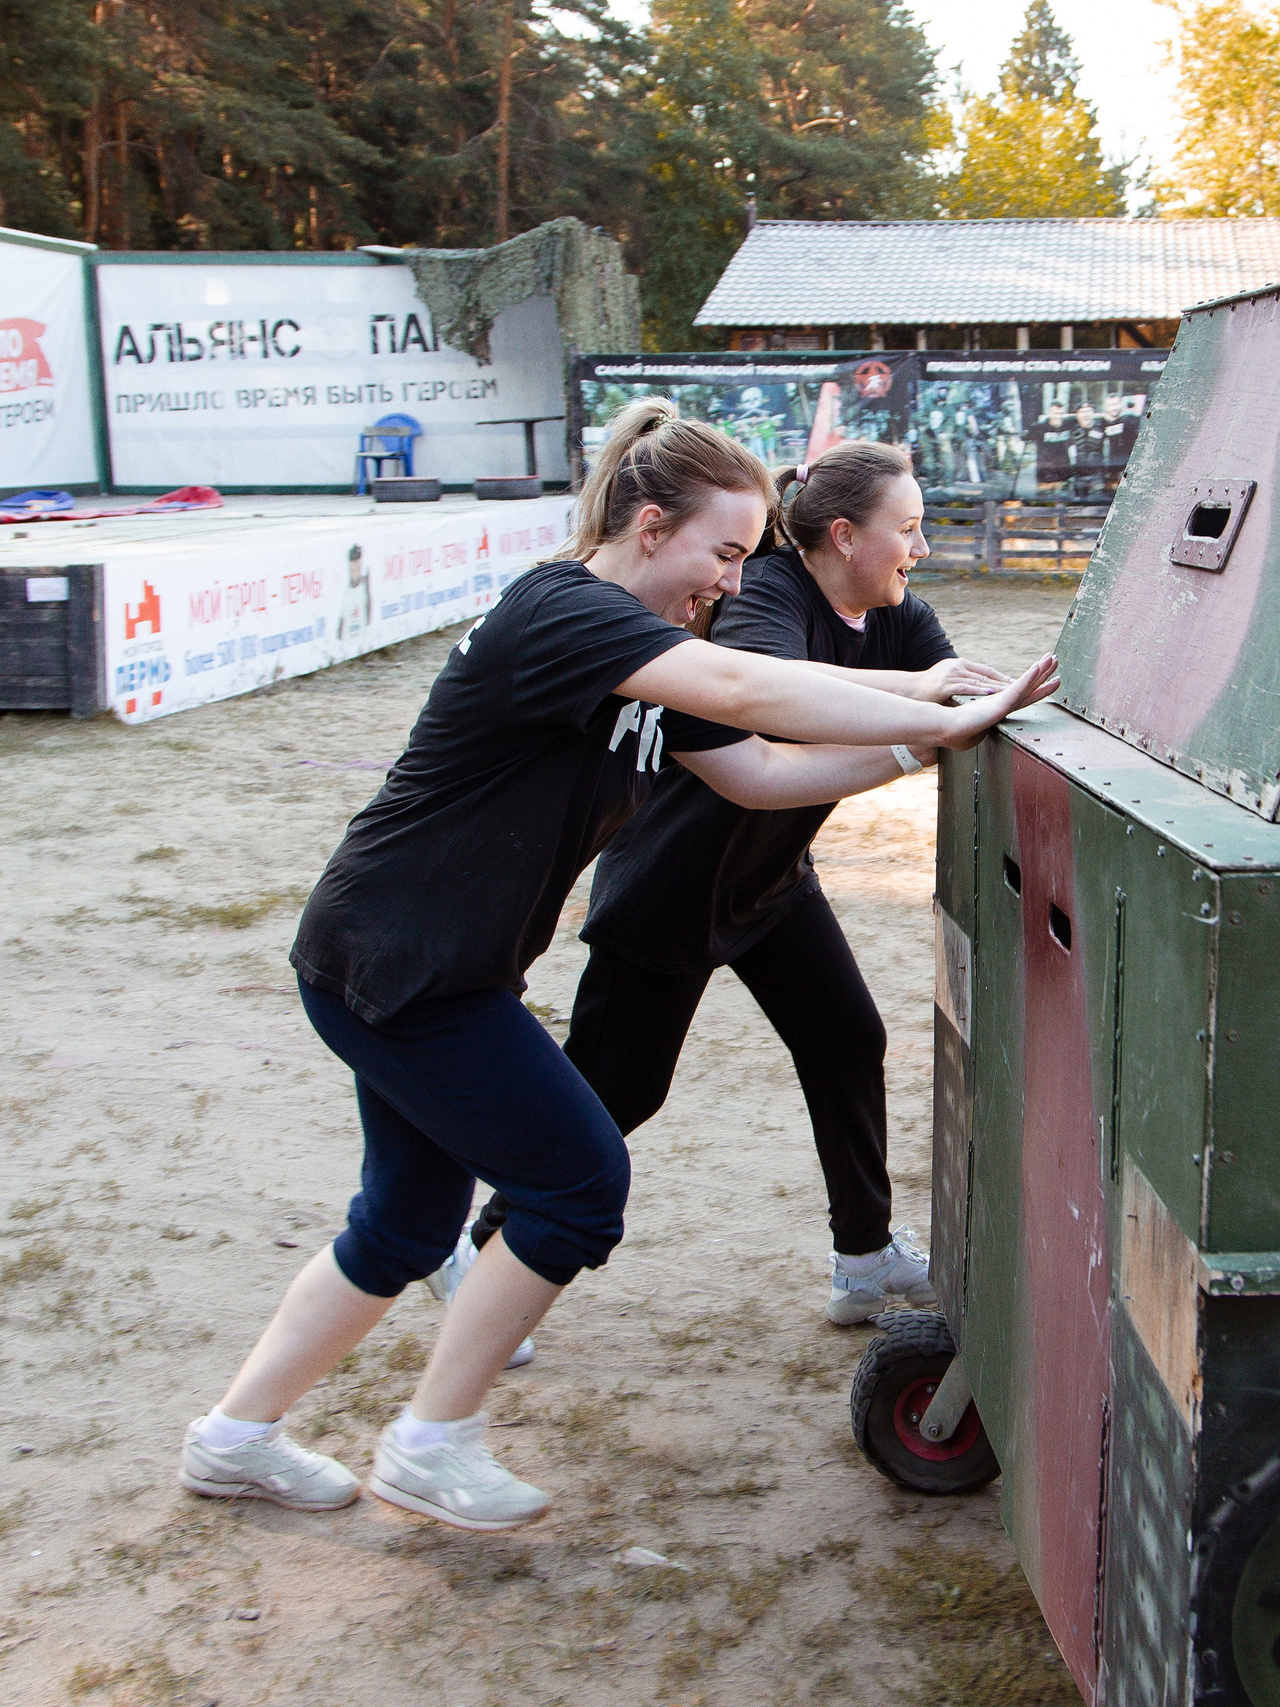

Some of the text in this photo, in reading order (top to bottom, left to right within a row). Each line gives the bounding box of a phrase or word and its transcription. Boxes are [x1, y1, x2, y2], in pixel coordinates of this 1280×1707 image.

[114, 313, 440, 365] АЛЬЯНС ПА
[594, 362, 643, 376] САМЫЙ
[926, 360, 1112, 373] ПРИШЛО ВРЕМЯ СТАТЬ ГЕРОЕМ
[0, 399, 54, 428] ЕРОЕМ
[116, 377, 500, 415] ПРИШЛО ВРЕМЯ БЫТЬ ГЕРОЕМ
[189, 580, 222, 628] МОЙ
[225, 578, 269, 618] ГОРОД
[115, 655, 172, 697] ПЕРМЬ
